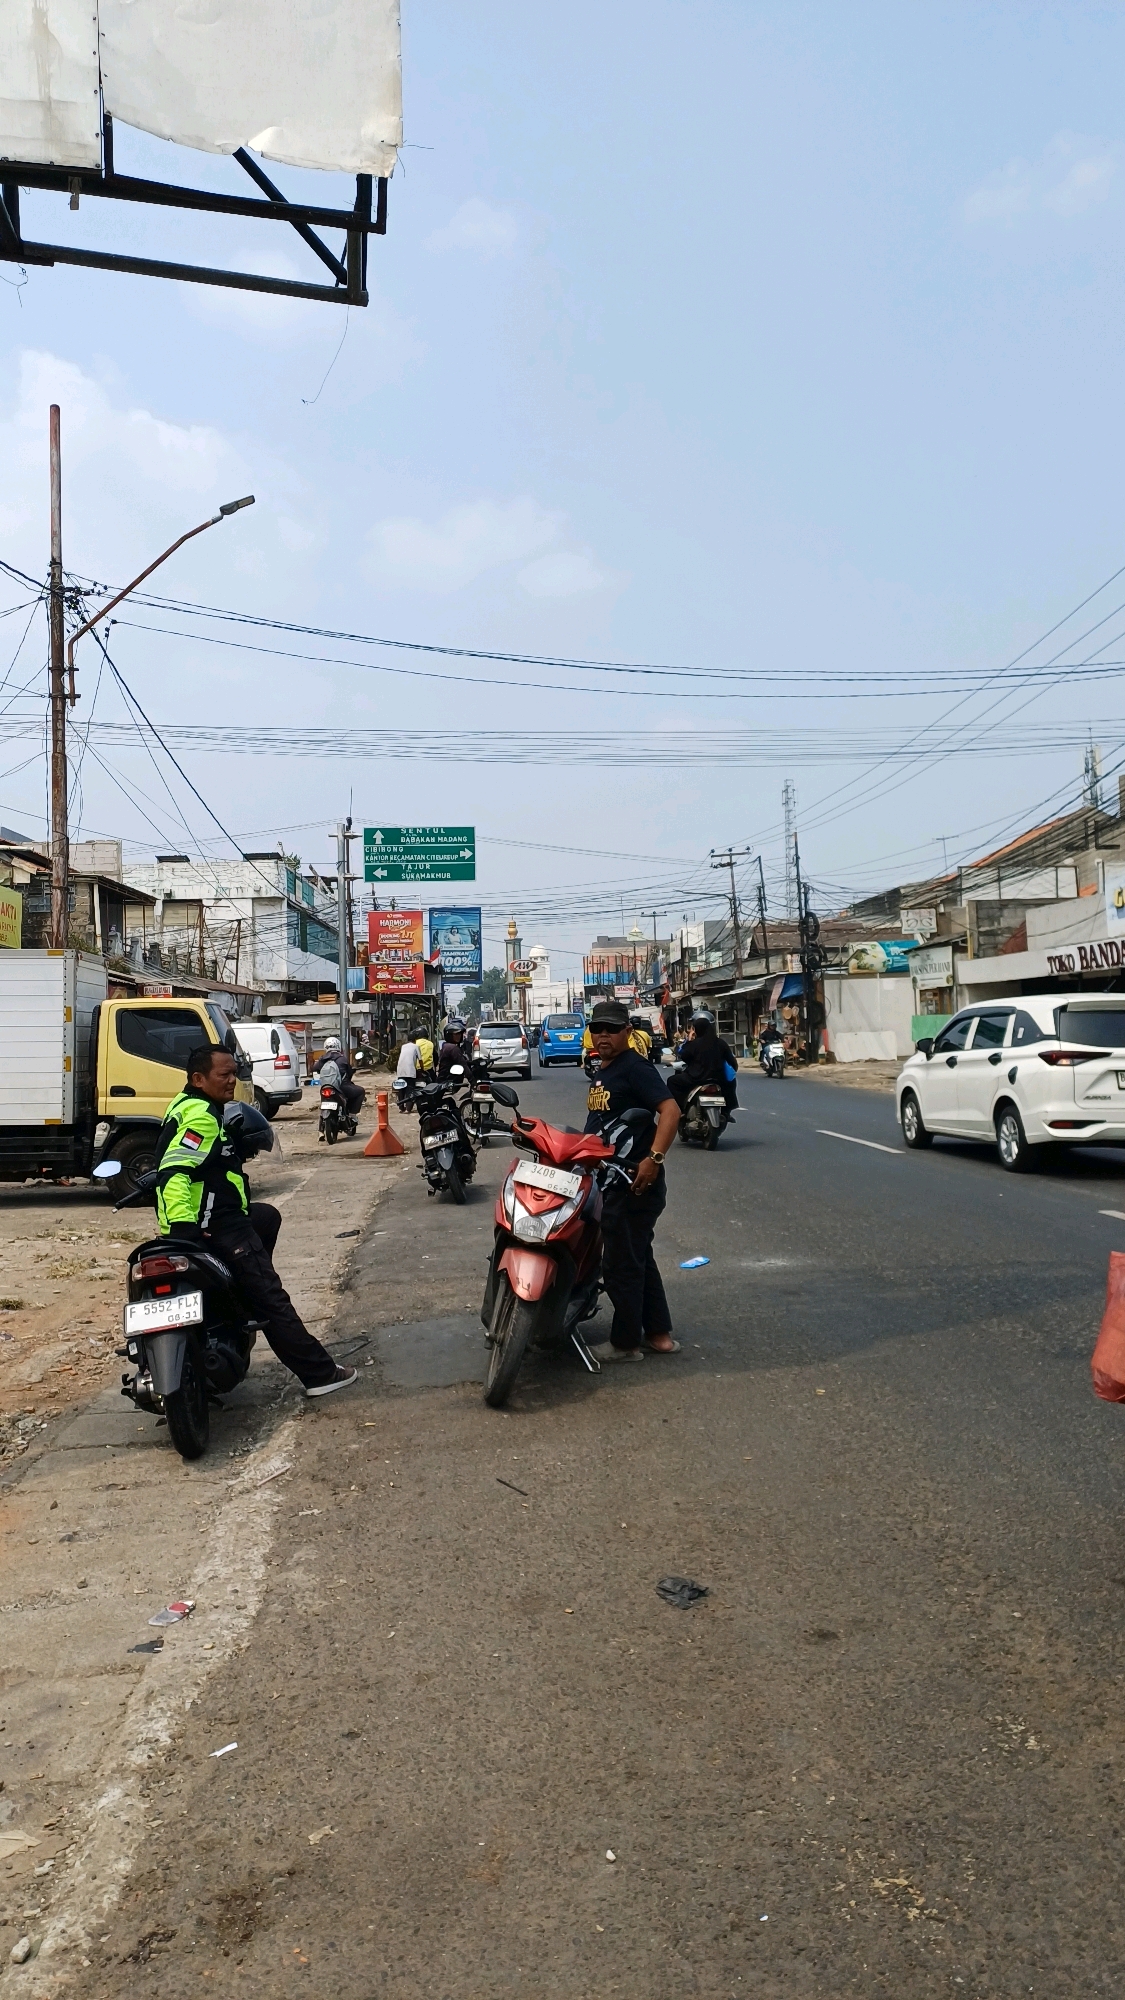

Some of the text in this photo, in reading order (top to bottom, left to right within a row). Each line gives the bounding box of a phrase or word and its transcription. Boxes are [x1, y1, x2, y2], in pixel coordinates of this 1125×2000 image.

[401, 872, 452, 880] SUKAMAKMUR
[380, 919, 412, 927] HARMONI
[1047, 953, 1076, 974] TOKO
[519, 1161, 580, 1186] F 3408 JA
[129, 1294, 199, 1319] F 5552 FLX
